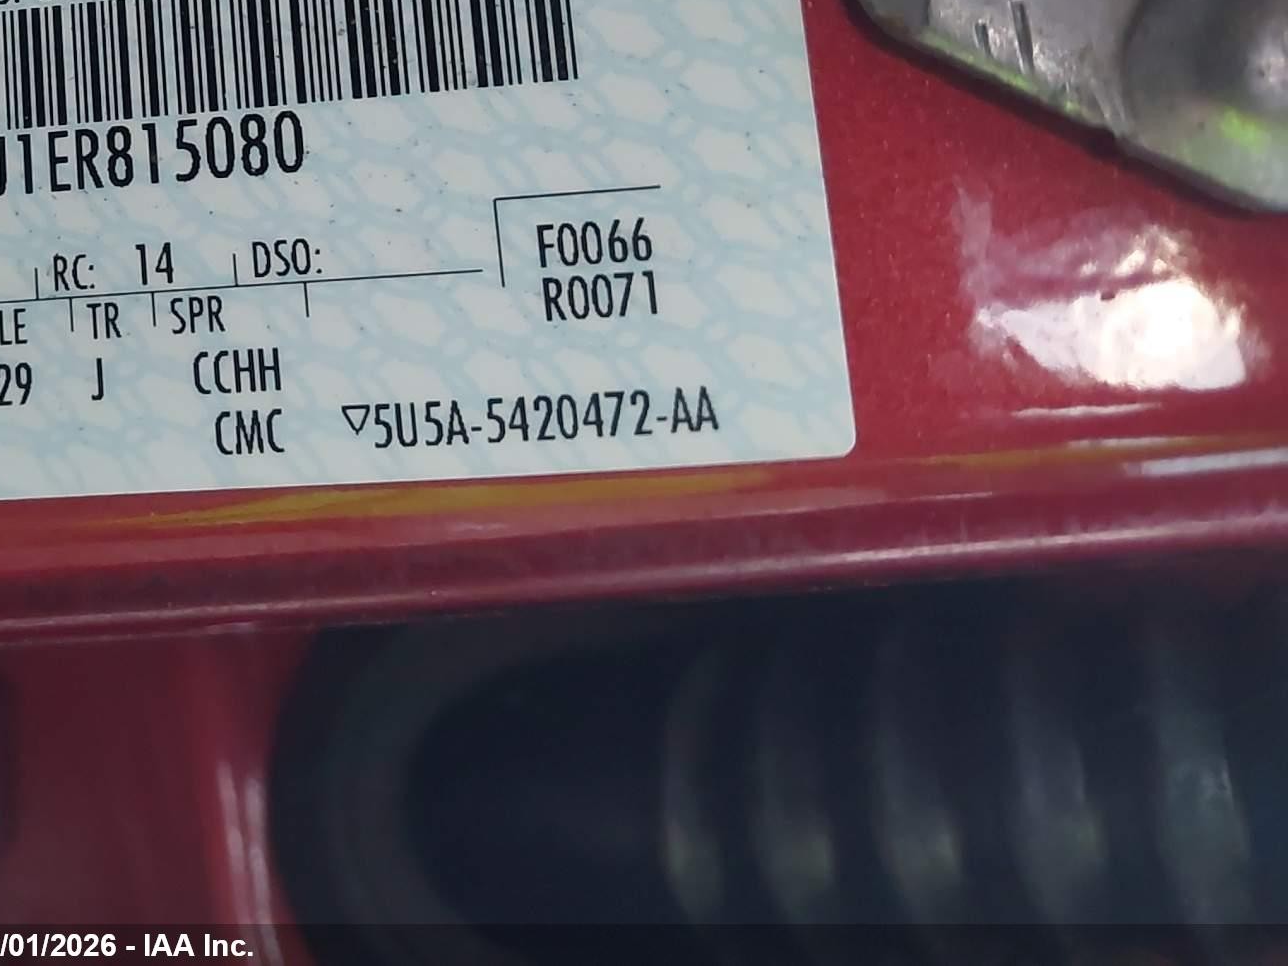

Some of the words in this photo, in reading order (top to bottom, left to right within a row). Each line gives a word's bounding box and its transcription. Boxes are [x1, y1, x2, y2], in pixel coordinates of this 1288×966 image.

[53, 253, 94, 292] RC:
[134, 242, 175, 285] 14
[252, 238, 322, 278] DSO:
[535, 218, 653, 268] F0066
[86, 301, 121, 340] TR
[171, 295, 226, 335] SPR
[541, 271, 658, 322] R0071
[91, 358, 105, 400] J
[192, 347, 282, 395] CCHH
[215, 408, 286, 456] CMC
[373, 386, 720, 450] 5U5A-5420472-AA
